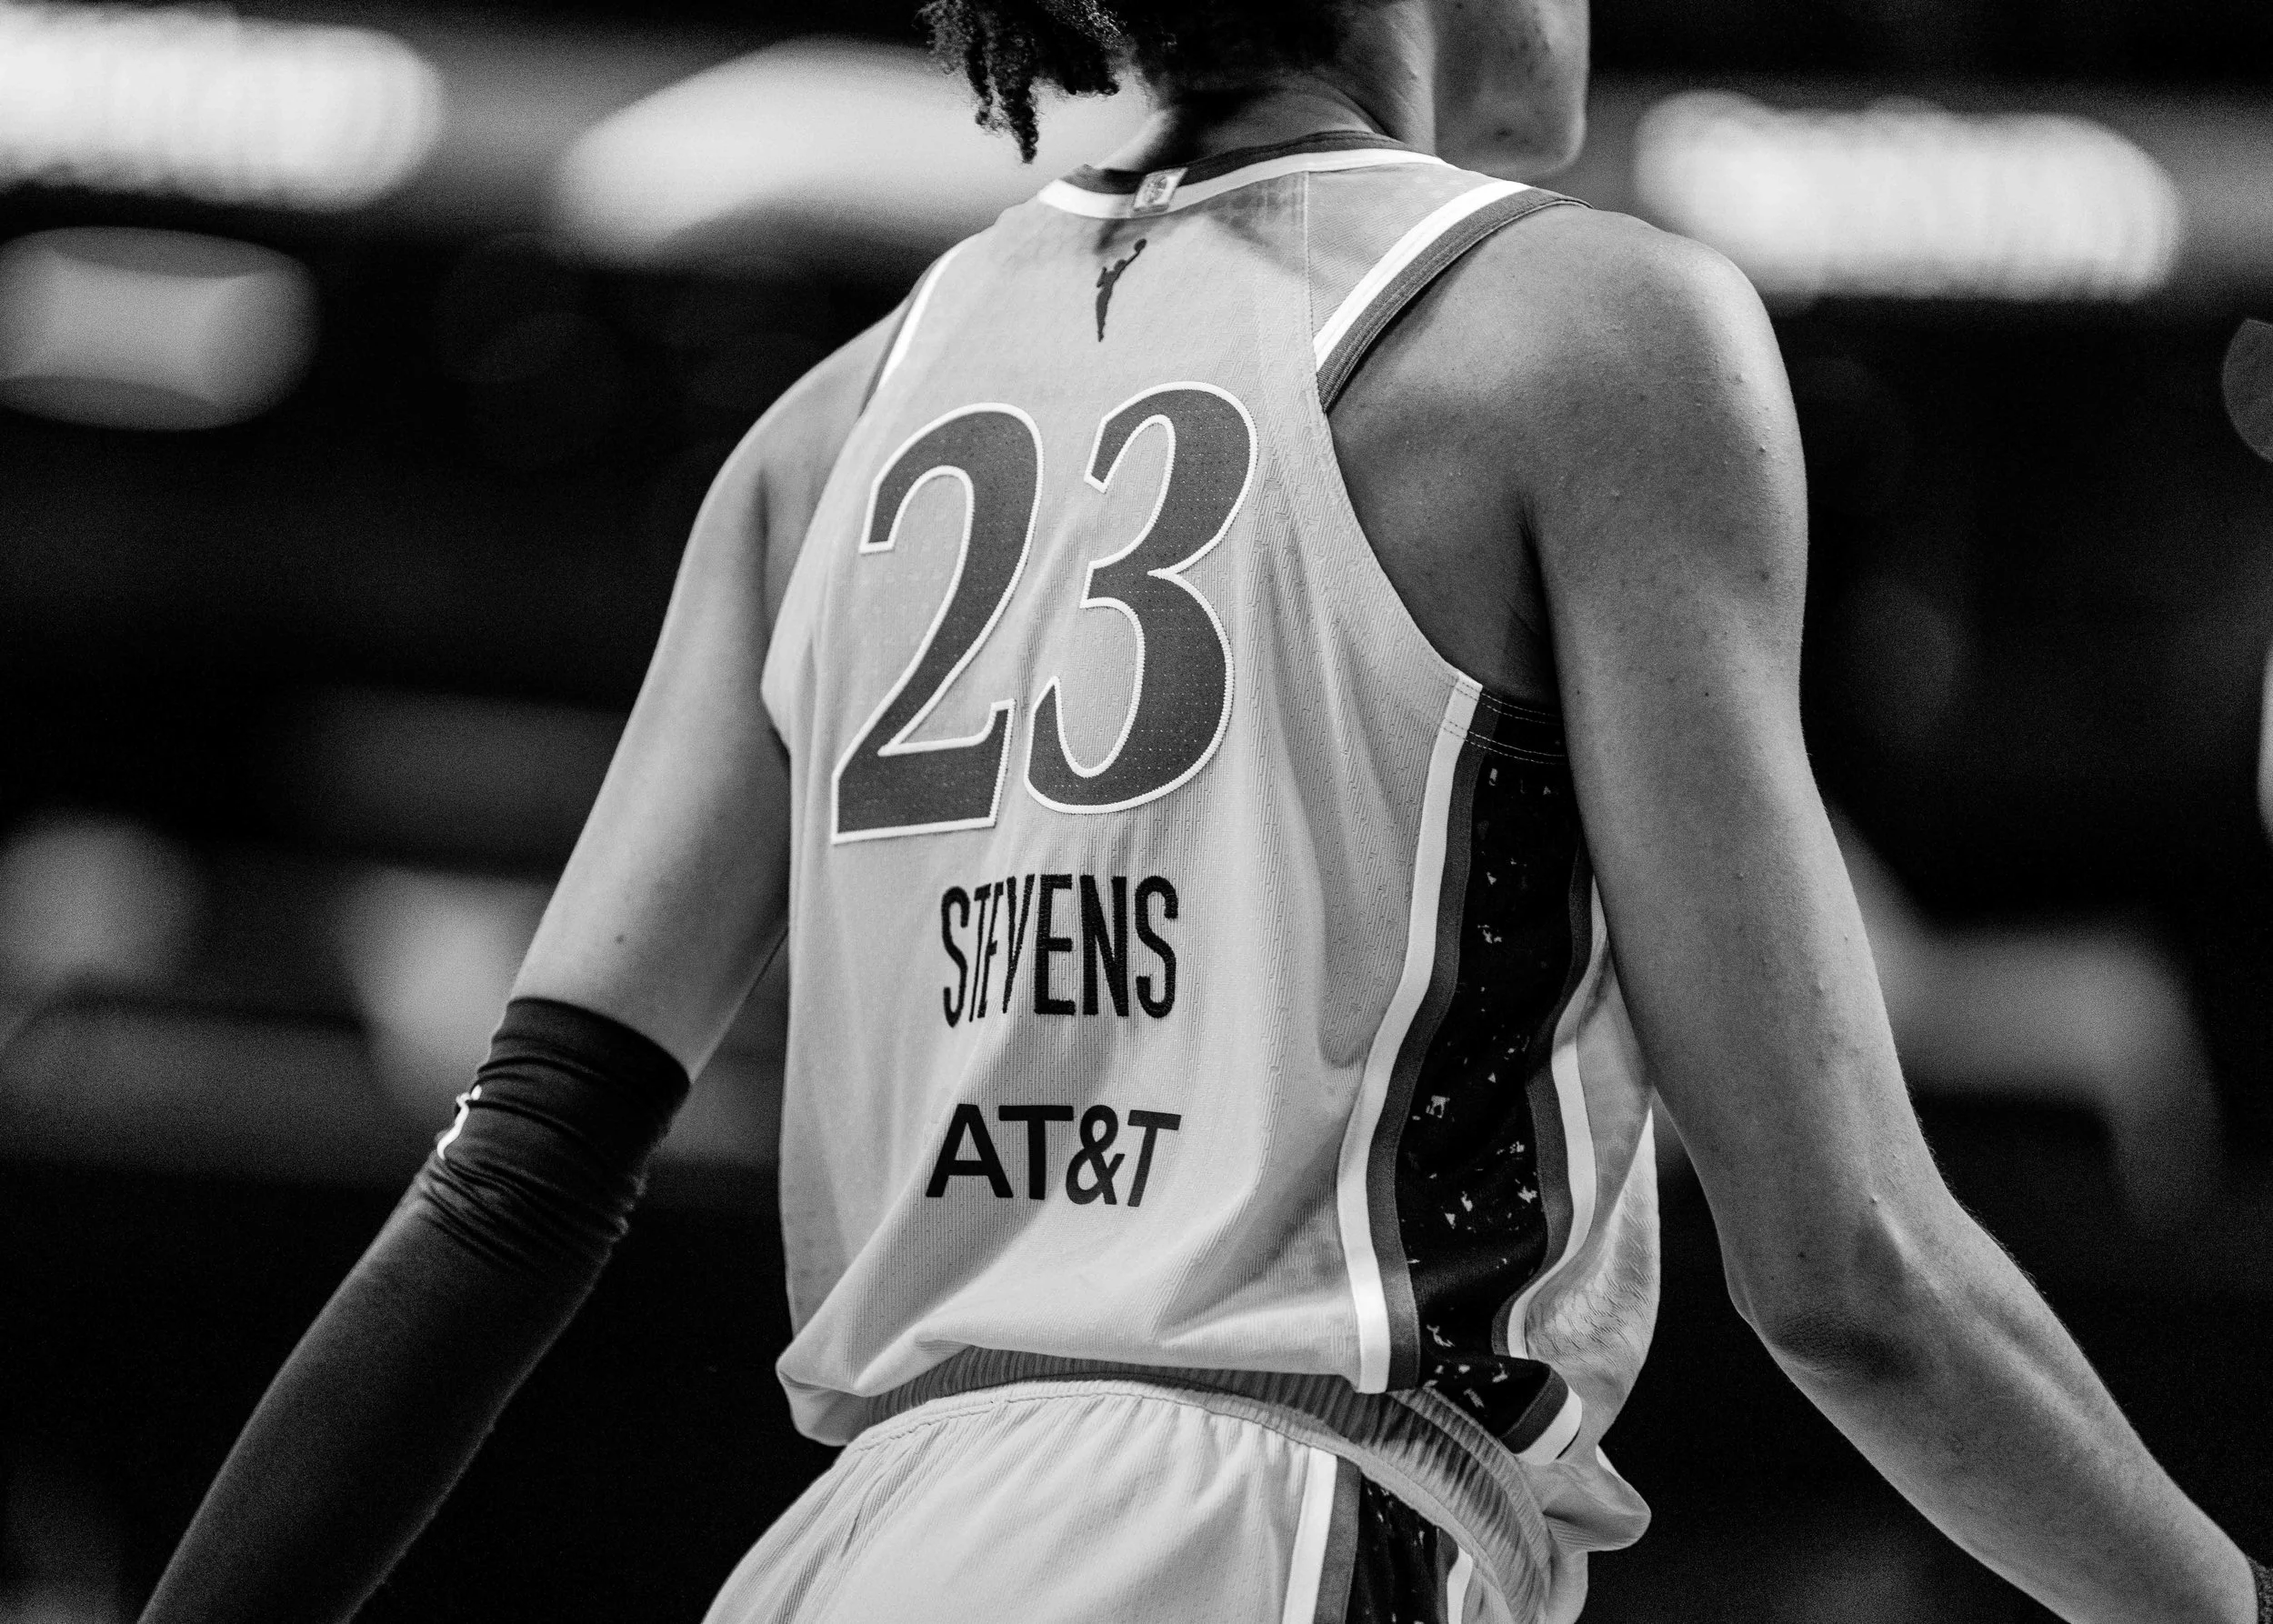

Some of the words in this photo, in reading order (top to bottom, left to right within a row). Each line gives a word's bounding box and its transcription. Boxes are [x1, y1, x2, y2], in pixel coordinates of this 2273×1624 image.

[831, 381, 1258, 845] 23
[941, 874, 1179, 1028] STEVENS
[926, 1103, 1182, 1208] AT&T
